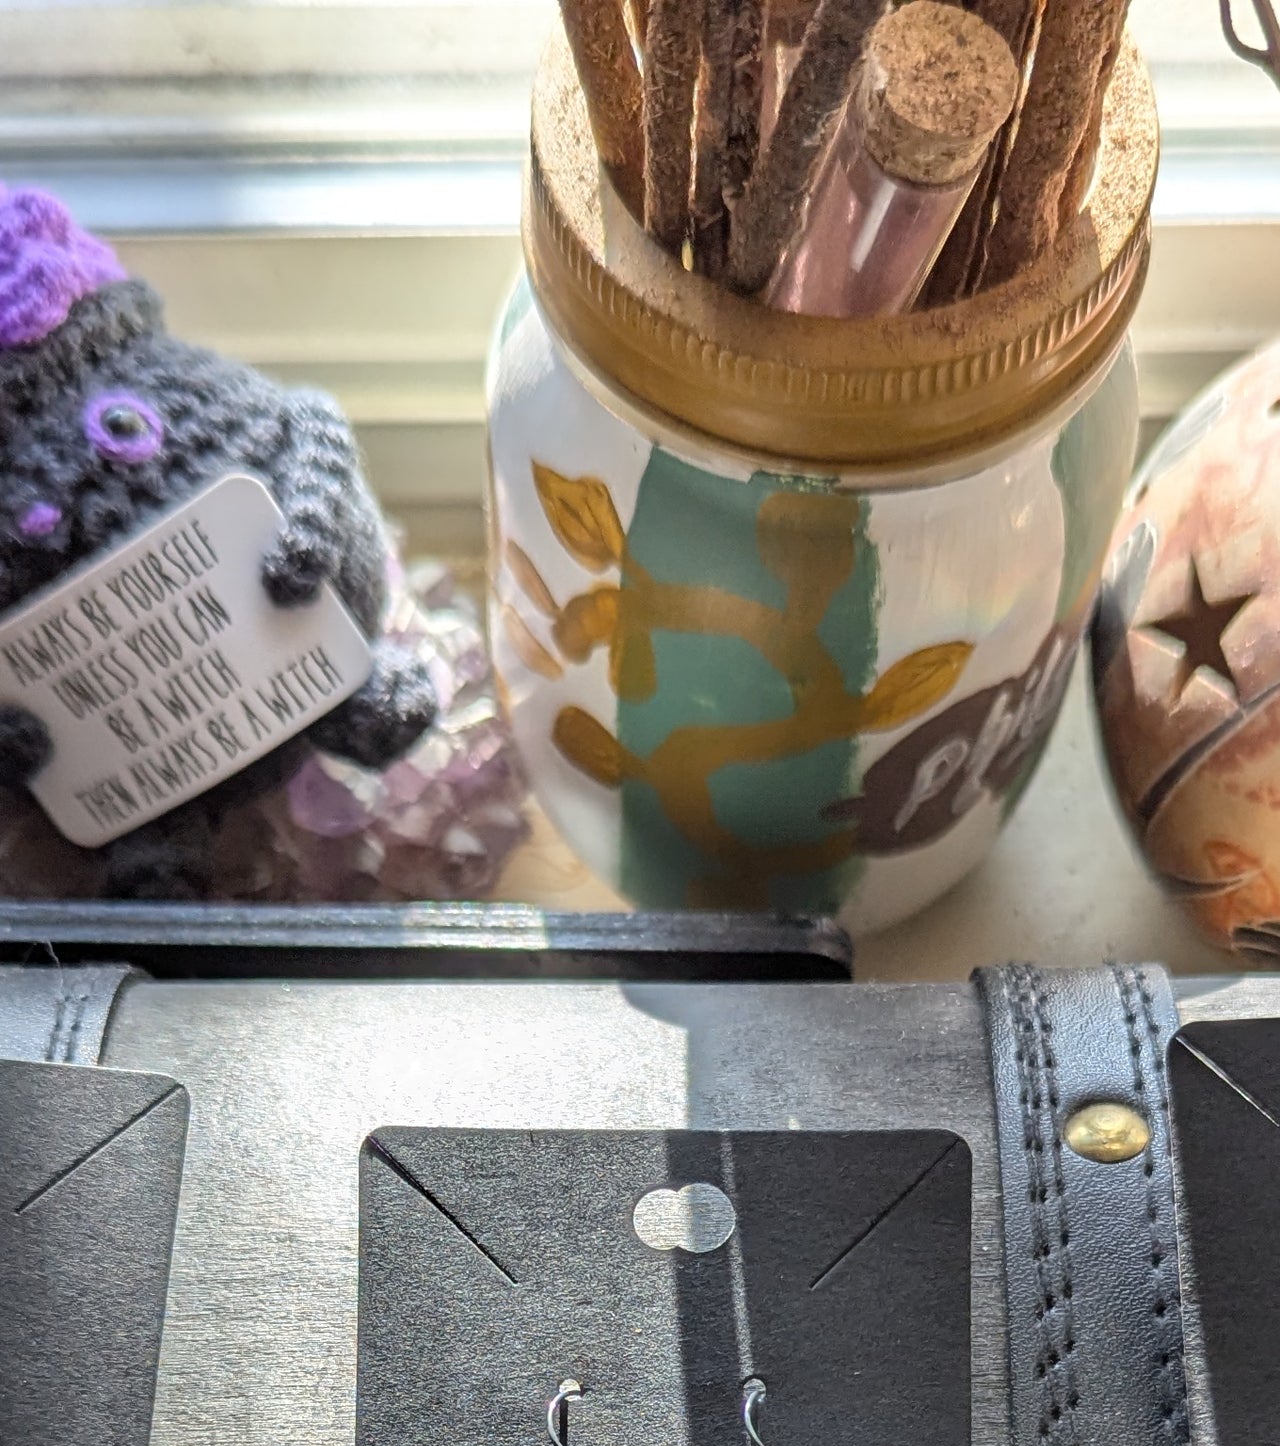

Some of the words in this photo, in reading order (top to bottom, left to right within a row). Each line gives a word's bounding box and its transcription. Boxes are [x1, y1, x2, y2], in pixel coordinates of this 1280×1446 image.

[0, 610, 91, 687] ALWAYS
[79, 588, 123, 640] BE
[106, 519, 220, 619] YOURSELF
[51, 649, 138, 721] UNLESS
[125, 619, 183, 680] YOU
[179, 585, 232, 643] CAN
[253, 645, 345, 725] WITCH
[103, 703, 148, 753] BE
[142, 695, 169, 739] A
[156, 649, 242, 726] WITCH
[206, 709, 250, 760] BE
[240, 698, 271, 742] A
[75, 775, 141, 830] THEN
[128, 729, 218, 804] ALWAYS
